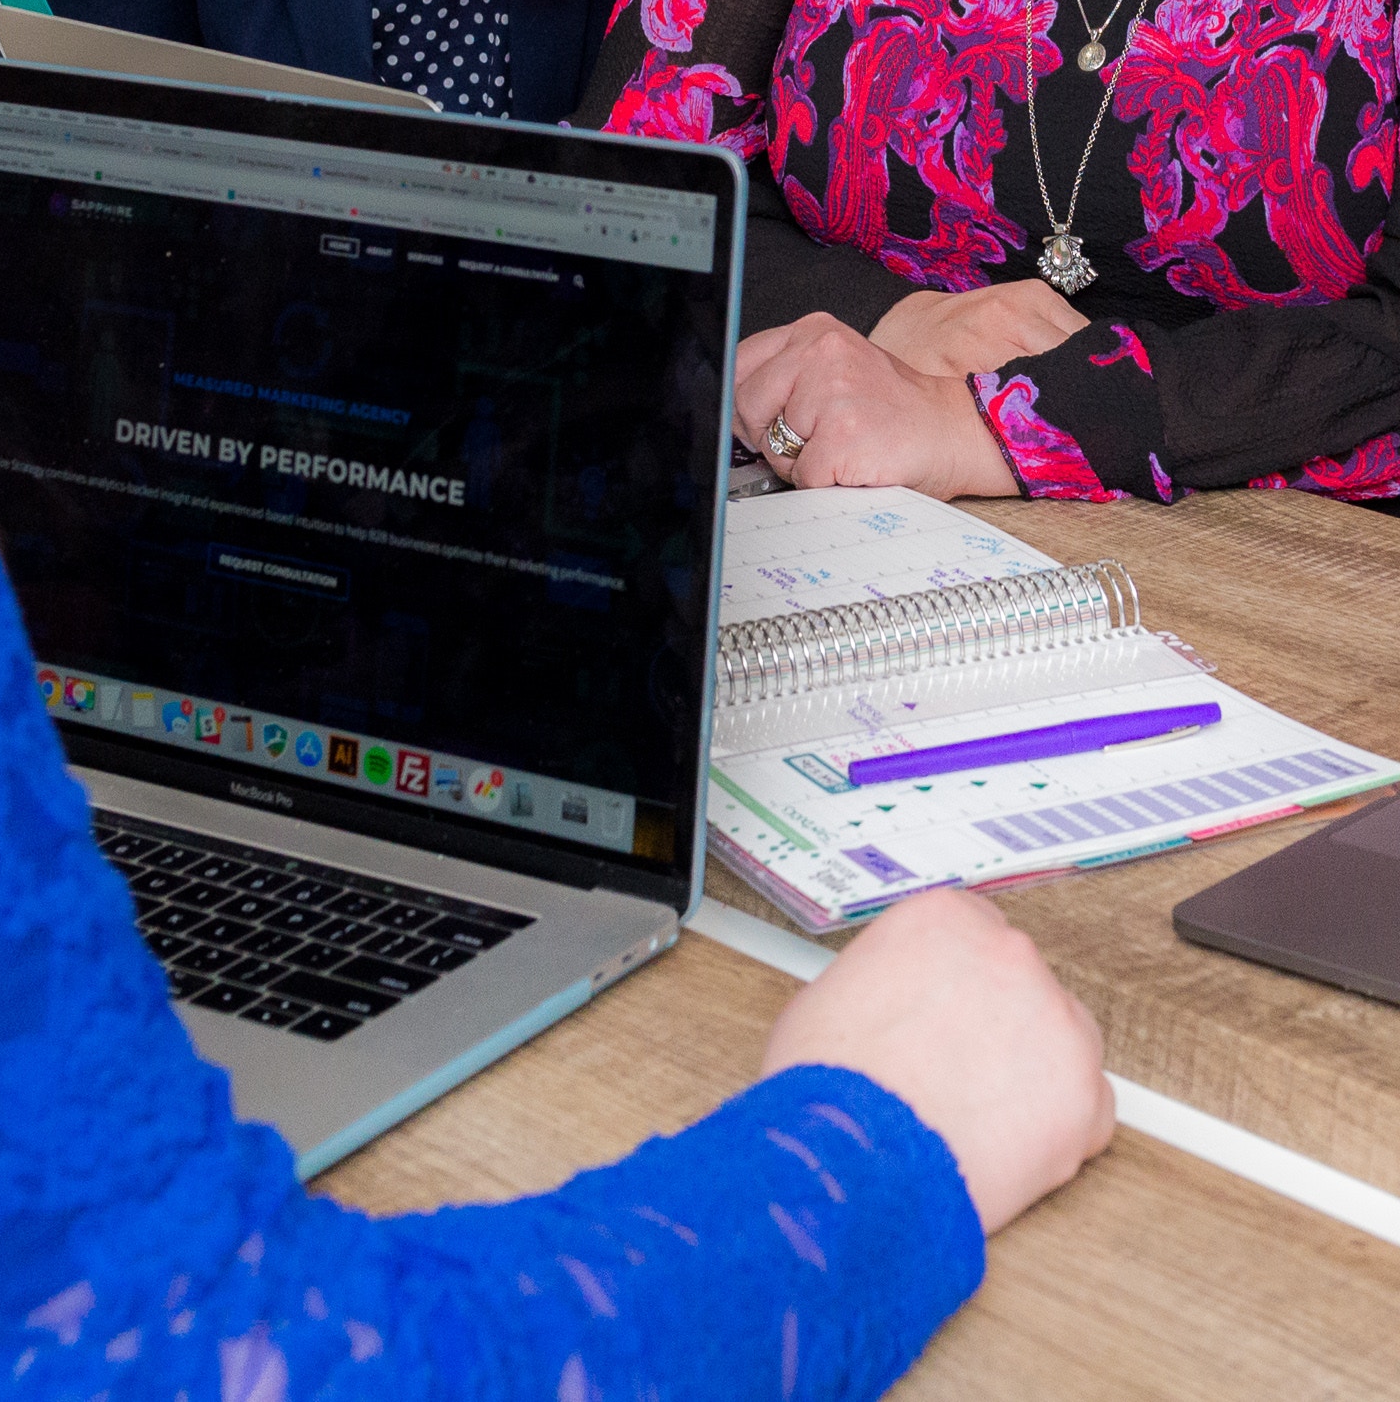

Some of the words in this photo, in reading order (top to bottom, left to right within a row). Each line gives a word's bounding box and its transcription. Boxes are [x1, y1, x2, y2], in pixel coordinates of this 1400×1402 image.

[70, 199, 133, 218] SAPPHIRE
[173, 373, 254, 398] MEASURED
[257, 386, 346, 415] MARKETING
[348, 402, 412, 426] AGENCY
[115, 418, 211, 458] DRIVEN
[218, 437, 254, 465] BY
[260, 445, 466, 507] PERFORMANCE
[219, 553, 263, 573] REQUEST
[264, 562, 338, 588] CONSULTATION
[231, 781, 274, 804] MacBook
[275, 791, 294, 809] Pro
